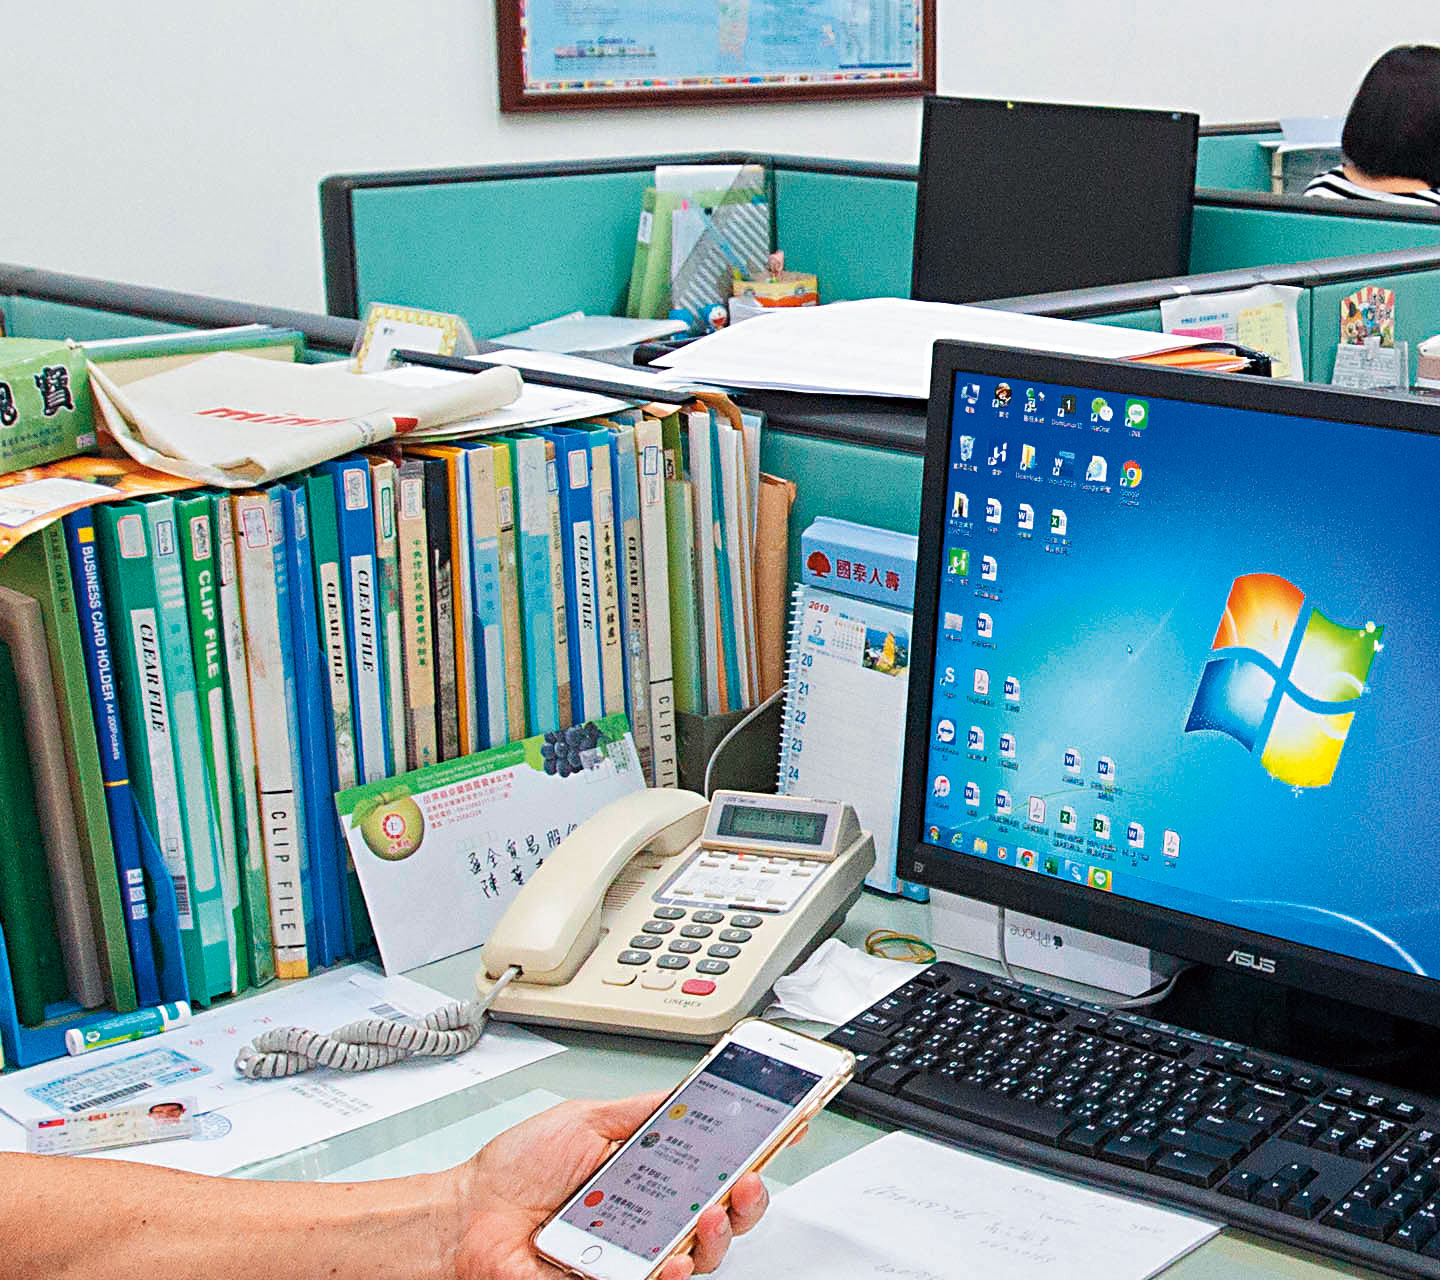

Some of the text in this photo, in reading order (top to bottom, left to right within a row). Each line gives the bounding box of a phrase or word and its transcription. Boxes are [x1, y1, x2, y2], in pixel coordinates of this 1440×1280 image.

[81, 545, 101, 609] BUSINESS
[577, 533, 594, 631] CLEAR FILE
[627, 534, 643, 633] CLEAR FILE
[835, 557, 902, 592] 國泰人壽
[91, 610, 107, 648] CARD
[198, 569, 221, 680] CLIP FILE
[356, 569, 375, 674] CLEAR FILE
[807, 600, 830, 615] 2019
[326, 580, 347, 687] CLEAR FILE
[96, 648, 117, 702] HOLDER
[138, 622, 166, 734] CLEAR FILE
[801, 652, 814, 668] 20
[798, 680, 811, 697] 21
[795, 708, 807, 726] 22
[657, 694, 677, 790] CLIP FIL
[791, 736, 804, 754] 23
[788, 765, 800, 782] 24
[271, 810, 297, 932] CLIP FILE
[1009, 923, 1054, 950] iPhone
[1226, 949, 1278, 974] ASUS
